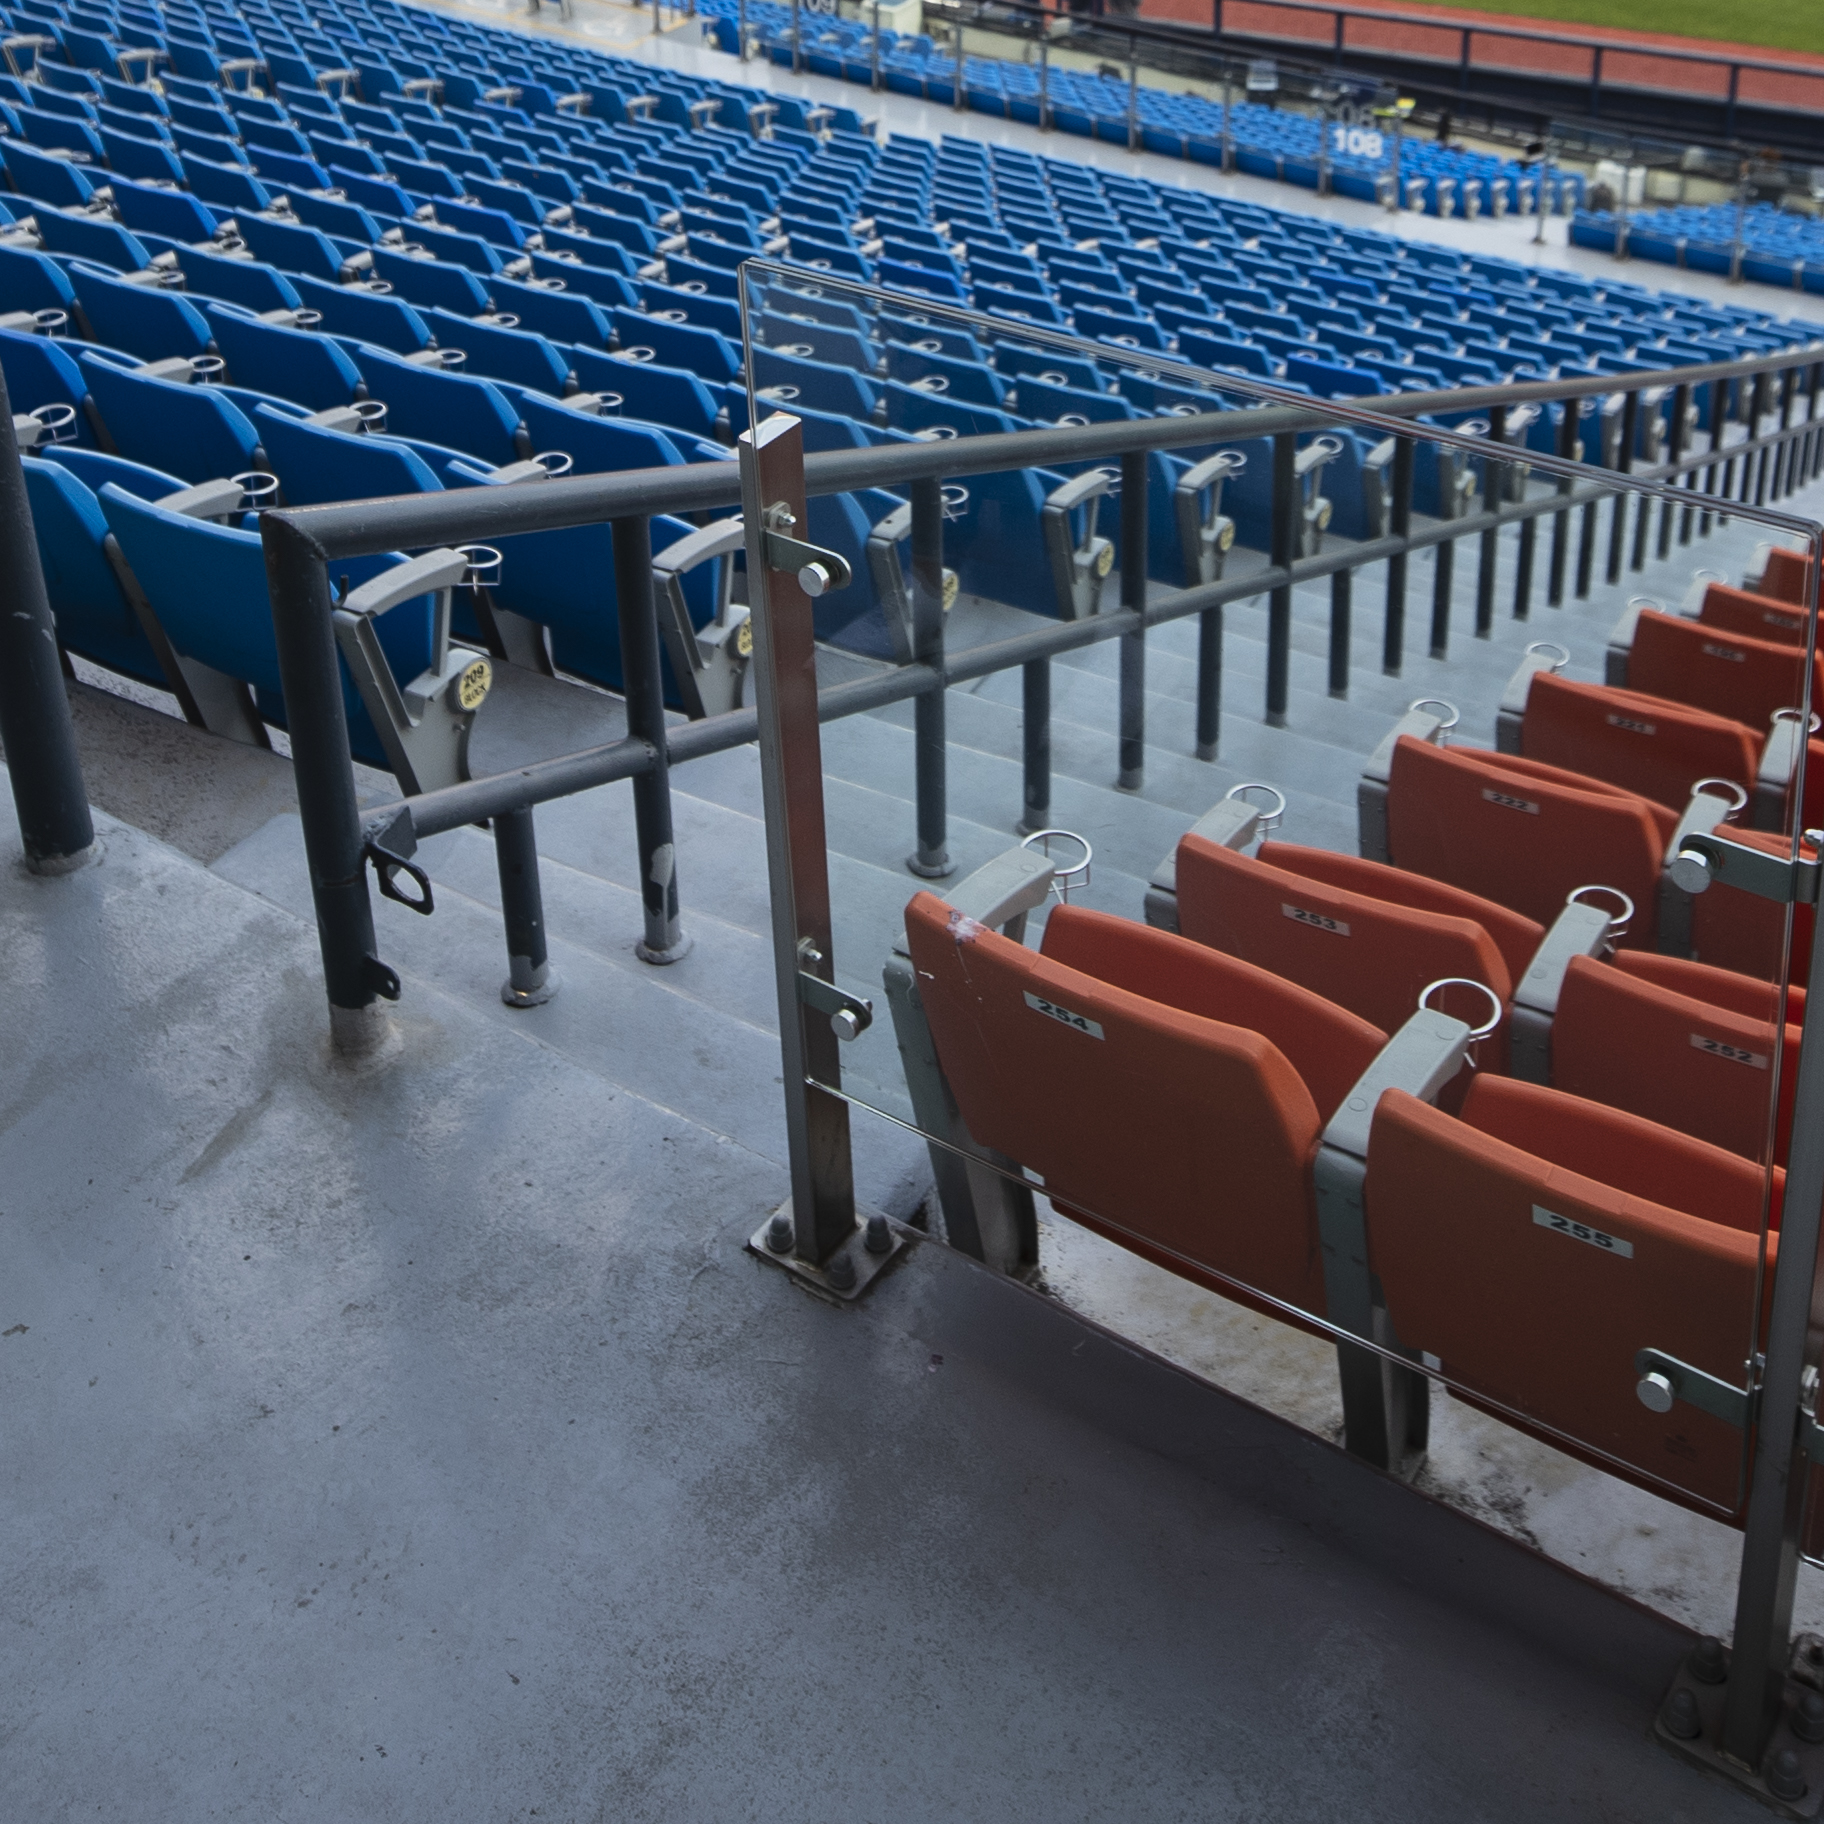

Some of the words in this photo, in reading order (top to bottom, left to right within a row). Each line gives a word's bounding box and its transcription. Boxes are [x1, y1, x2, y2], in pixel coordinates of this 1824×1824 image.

[1333, 129, 1383, 159] 108
[464, 664, 484, 689] 209
[1491, 792, 1529, 811] 222
[1294, 908, 1339, 931] 253
[1037, 998, 1089, 1031] 254
[1701, 1039, 1754, 1064] 252
[1549, 1214, 1613, 1249] 255
